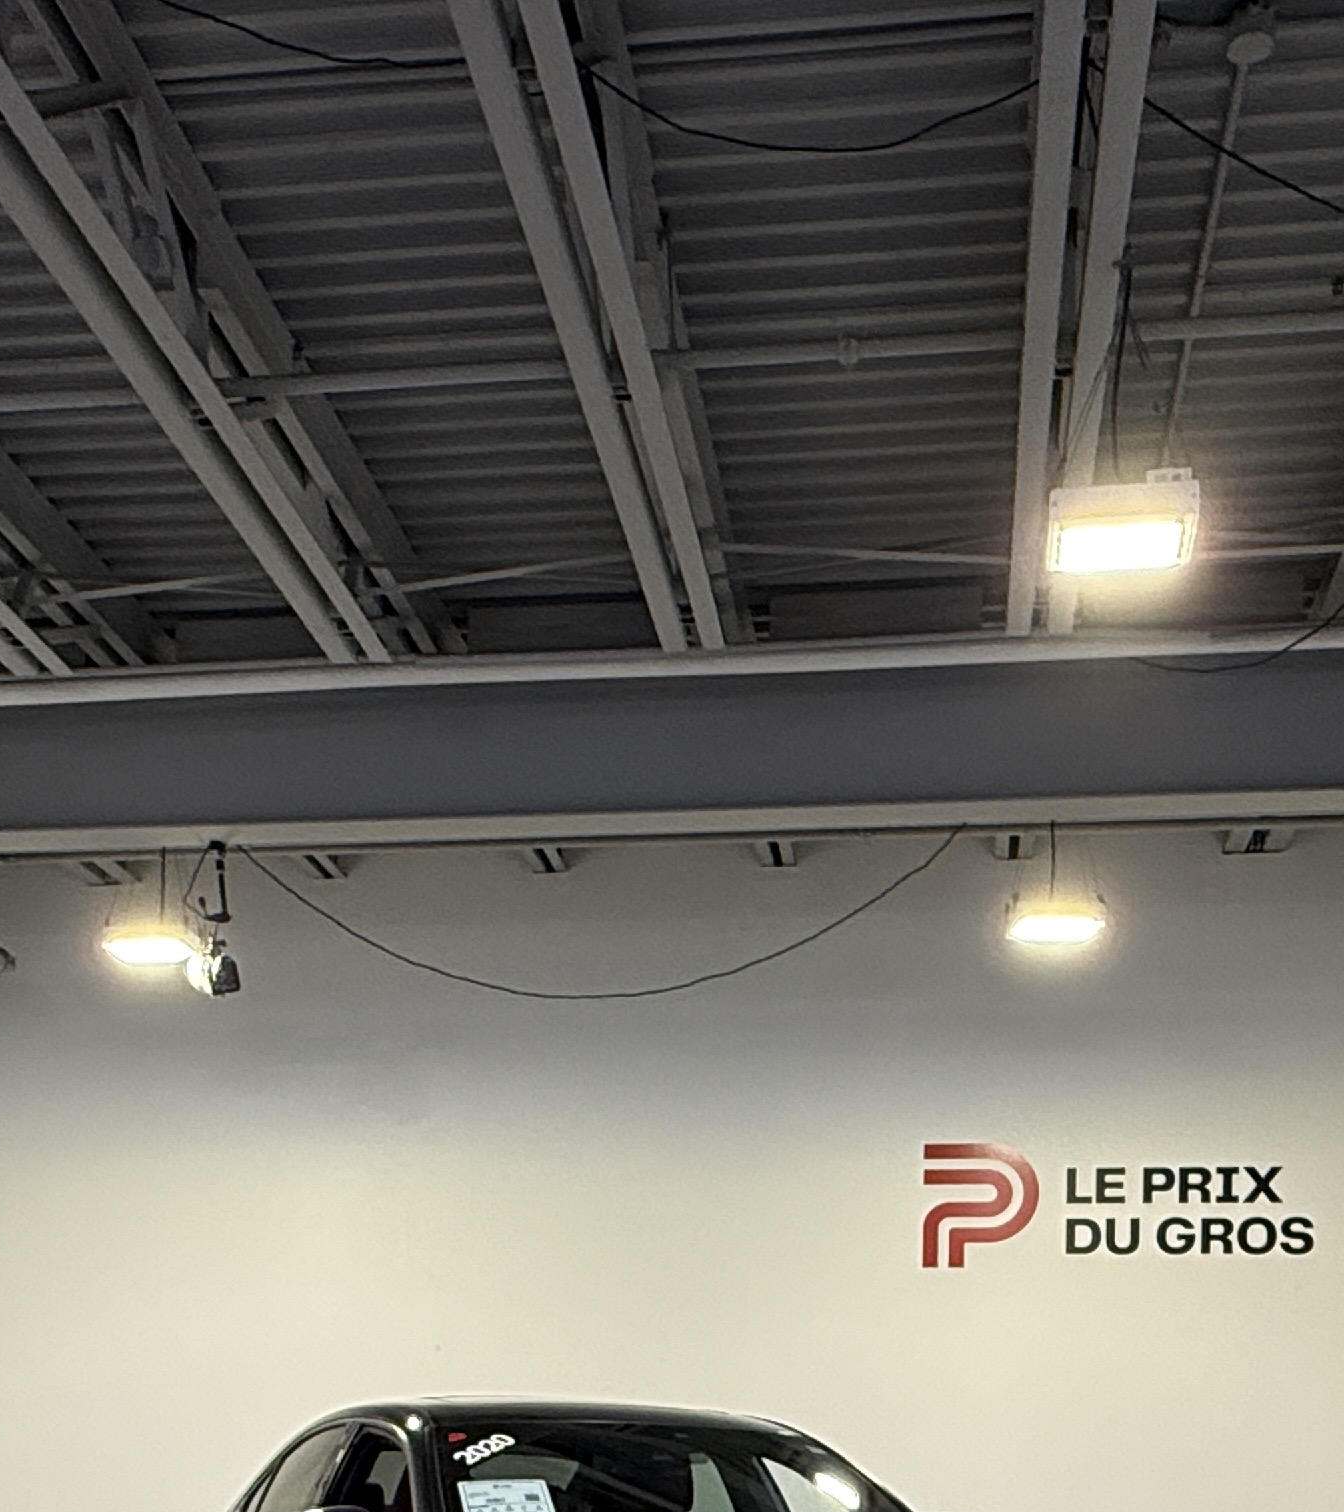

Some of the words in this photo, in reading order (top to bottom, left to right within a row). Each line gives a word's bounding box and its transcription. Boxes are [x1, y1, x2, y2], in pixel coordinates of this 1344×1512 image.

[1066, 1166, 1126, 1204] LE
[1142, 1166, 1283, 1204] PRIX
[1065, 1217, 1140, 1255] DU
[1156, 1216, 1314, 1255] GROS
[453, 1434, 516, 1465] 2020
